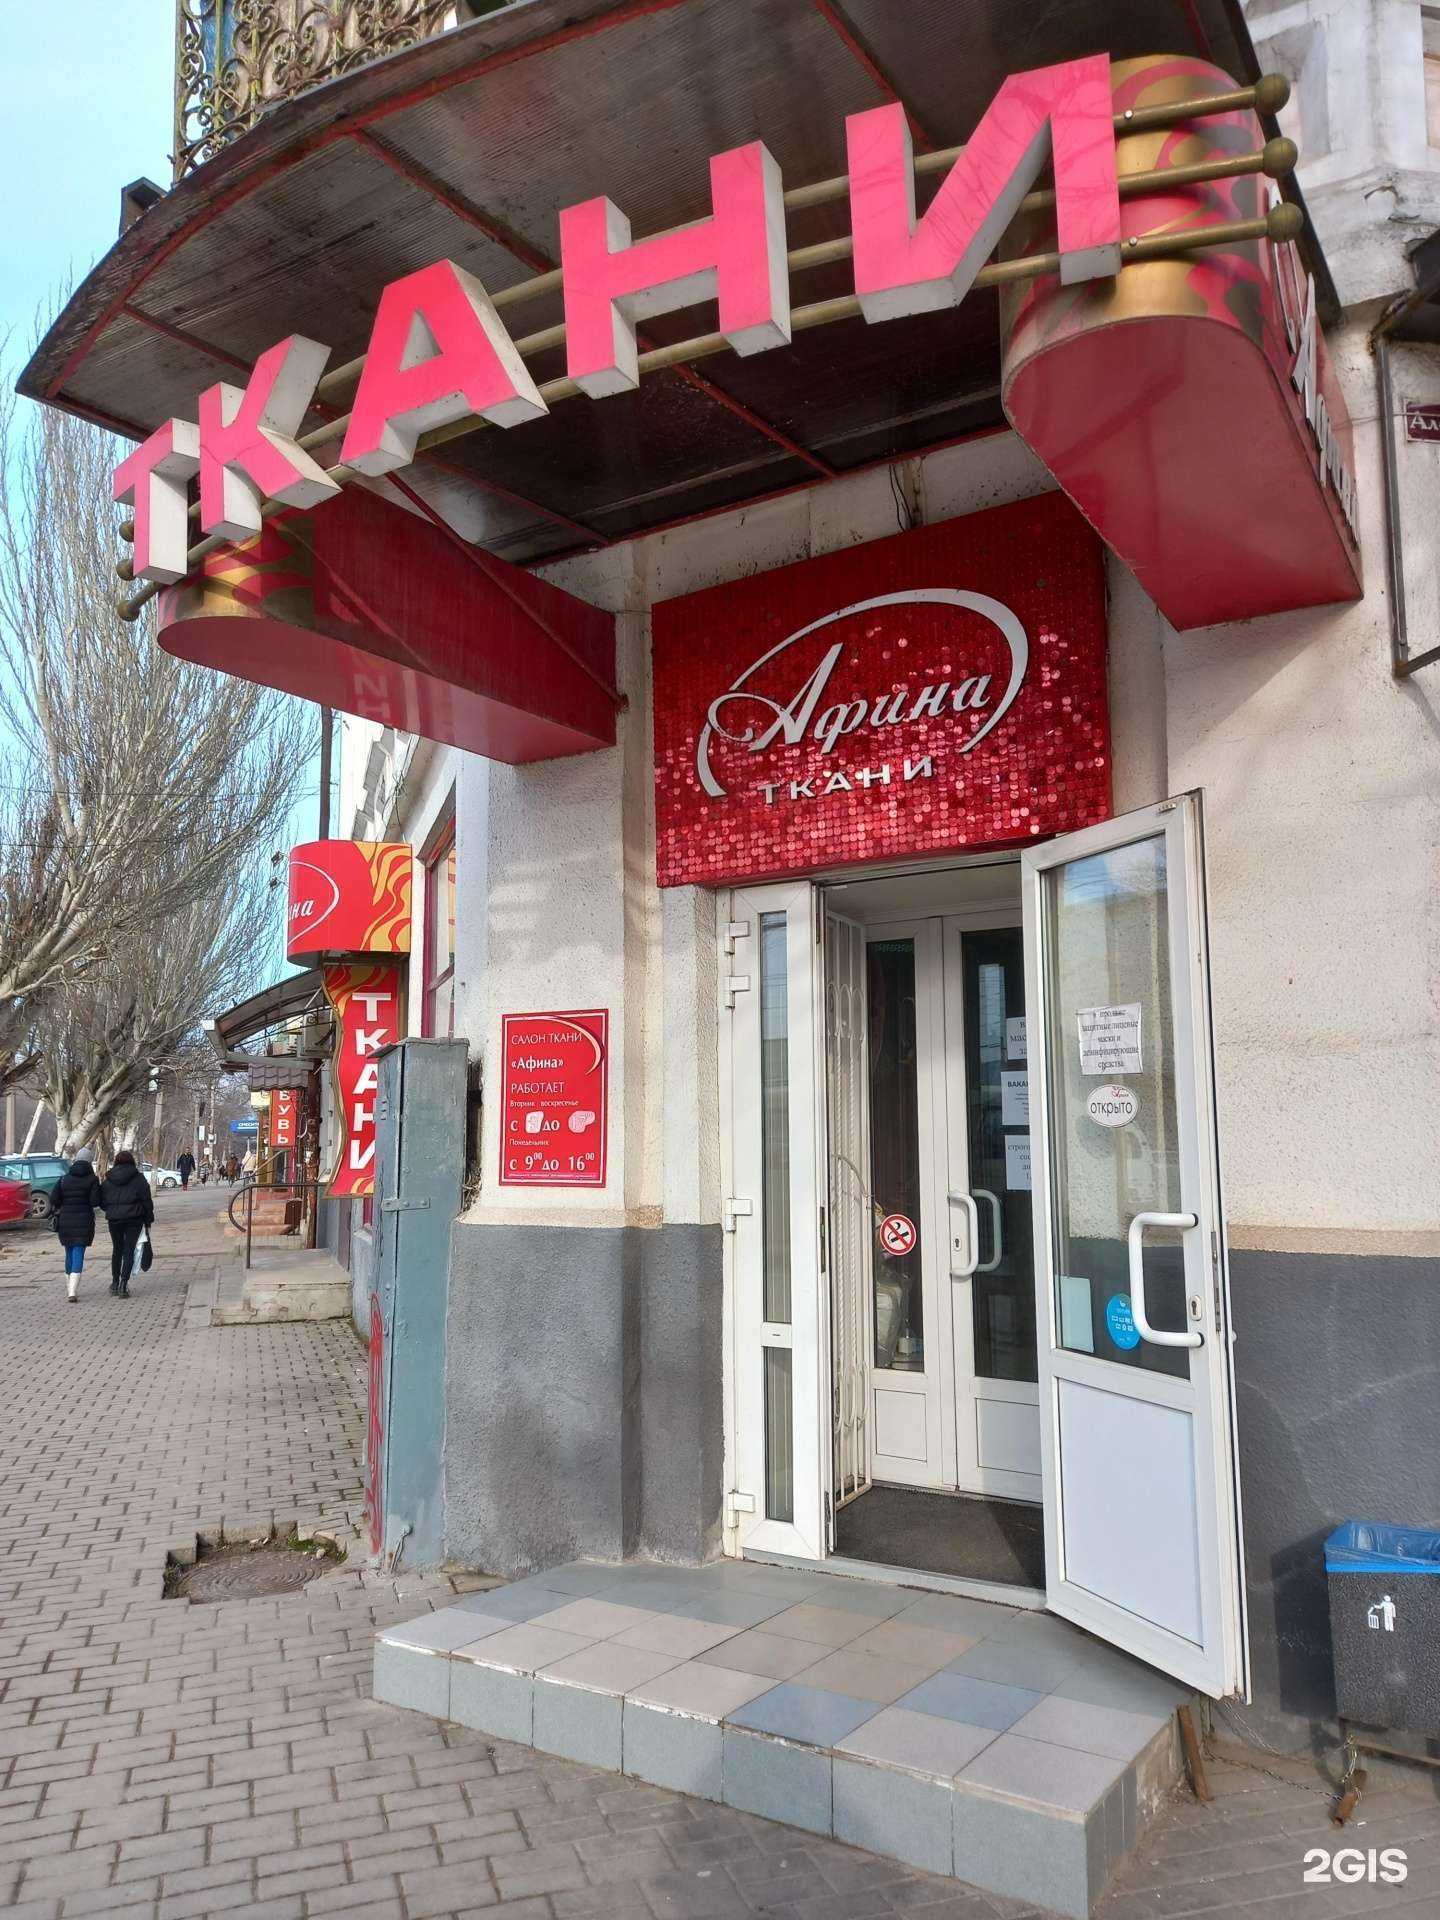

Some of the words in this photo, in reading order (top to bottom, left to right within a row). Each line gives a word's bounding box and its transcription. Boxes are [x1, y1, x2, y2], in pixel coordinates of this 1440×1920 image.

[112, 52, 1122, 586] ТКАНИ
[707, 642, 993, 754] Афина
[757, 755, 934, 804] ТКАНИ
[511, 1034, 546, 1045] САЛОН
[548, 1032, 583, 1043] ТКАНИ
[511, 1056, 564, 1072] «Афина»
[511, 1082, 565, 1094] РАБОТАЕТ
[278, 1090, 292, 1144] БУВЬ
